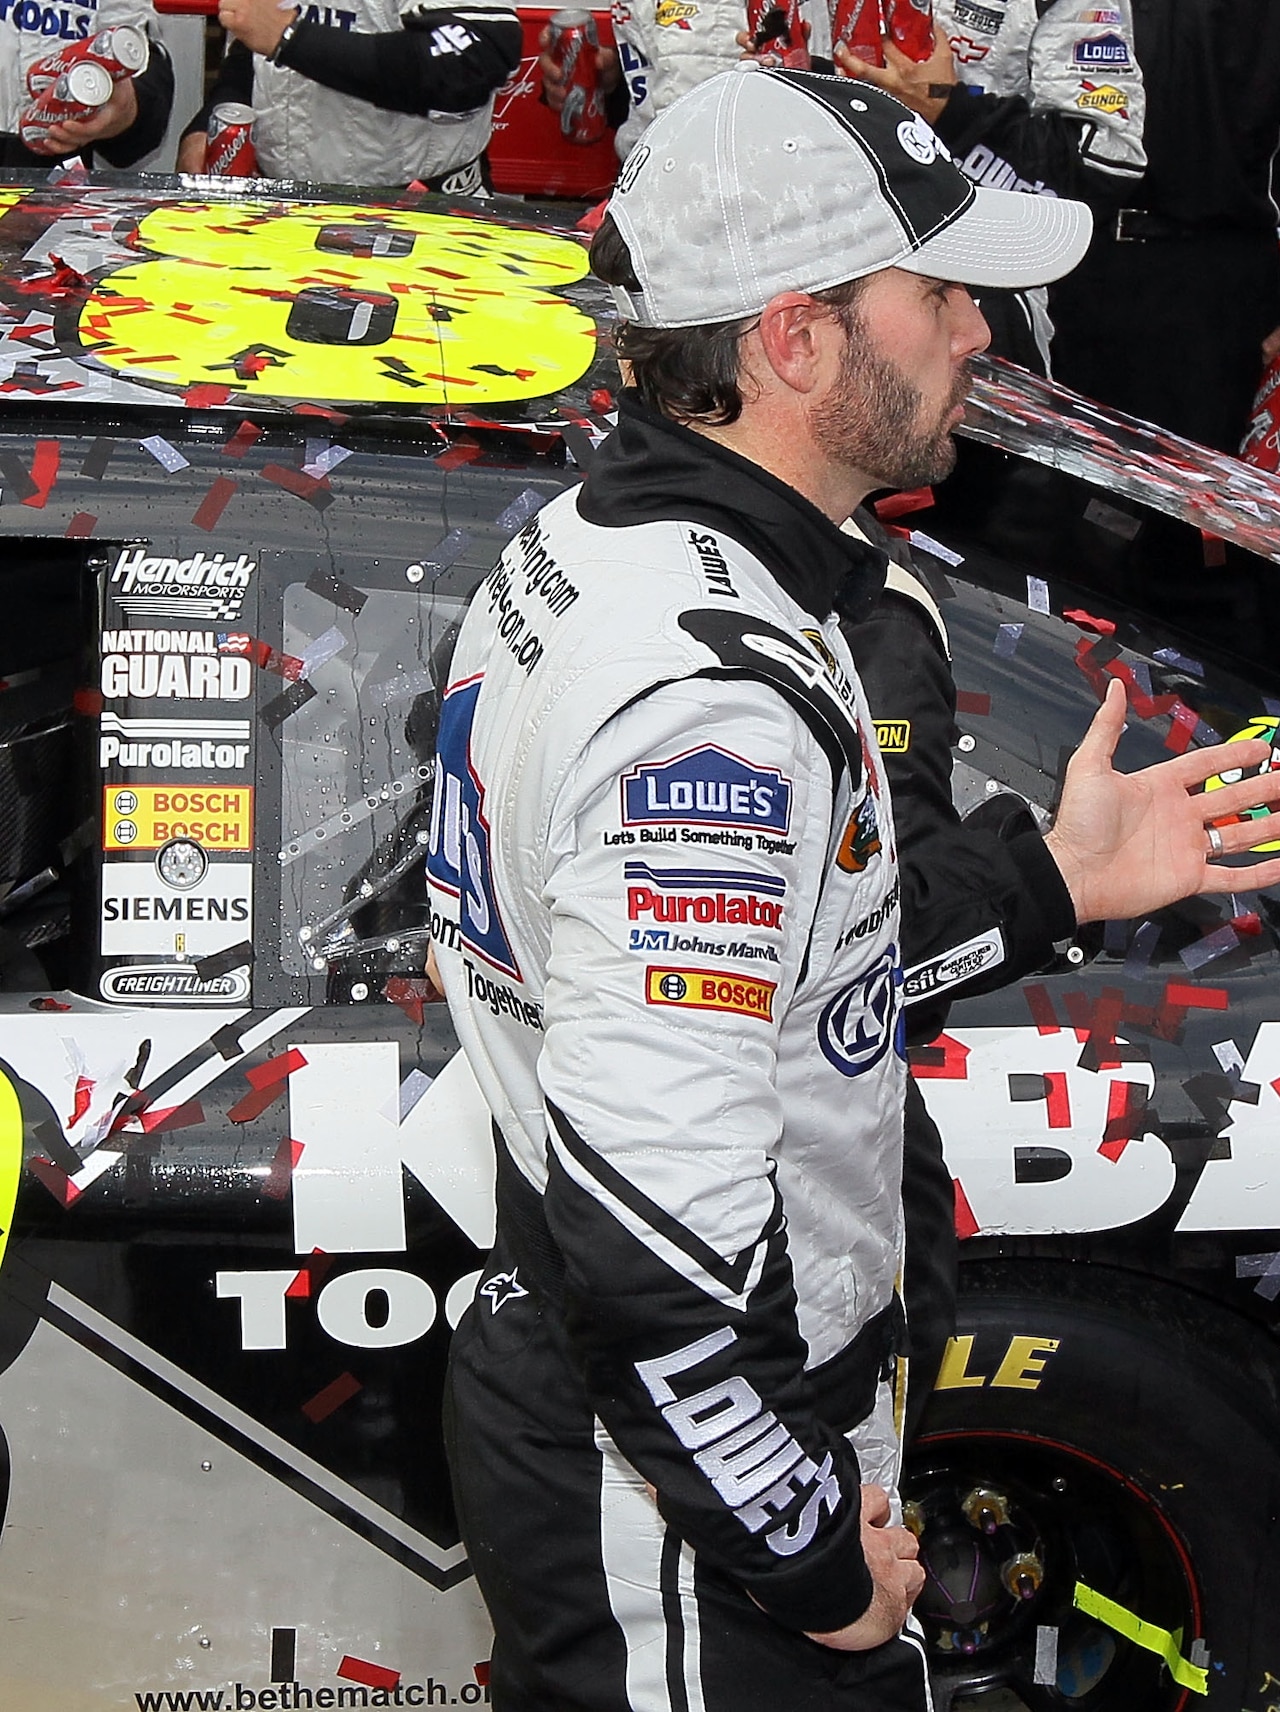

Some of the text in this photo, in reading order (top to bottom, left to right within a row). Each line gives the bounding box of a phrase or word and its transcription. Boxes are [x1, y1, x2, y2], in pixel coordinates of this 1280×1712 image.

[110, 549, 257, 593] Hendrick
[132, 582, 247, 599] MOTORSPORTS
[101, 630, 218, 654] NATIONAL
[101, 655, 252, 700] GUARD
[100, 735, 250, 769] Purolator
[152, 793, 241, 815] BOSCH
[645, 775, 774, 818] LOWE'S
[152, 821, 241, 843] BOSCH
[639, 828, 677, 844] Build
[680, 828, 754, 851] Something
[103, 897, 249, 922] SIEMENS
[626, 886, 785, 932] Purolator
[671, 933, 727, 956] Johns
[116, 975, 233, 995] FREIGHTLINER
[906, 968, 936, 994] sfi
[701, 979, 771, 1012] BOSCH
[633, 1325, 844, 1557] LOWE'S
